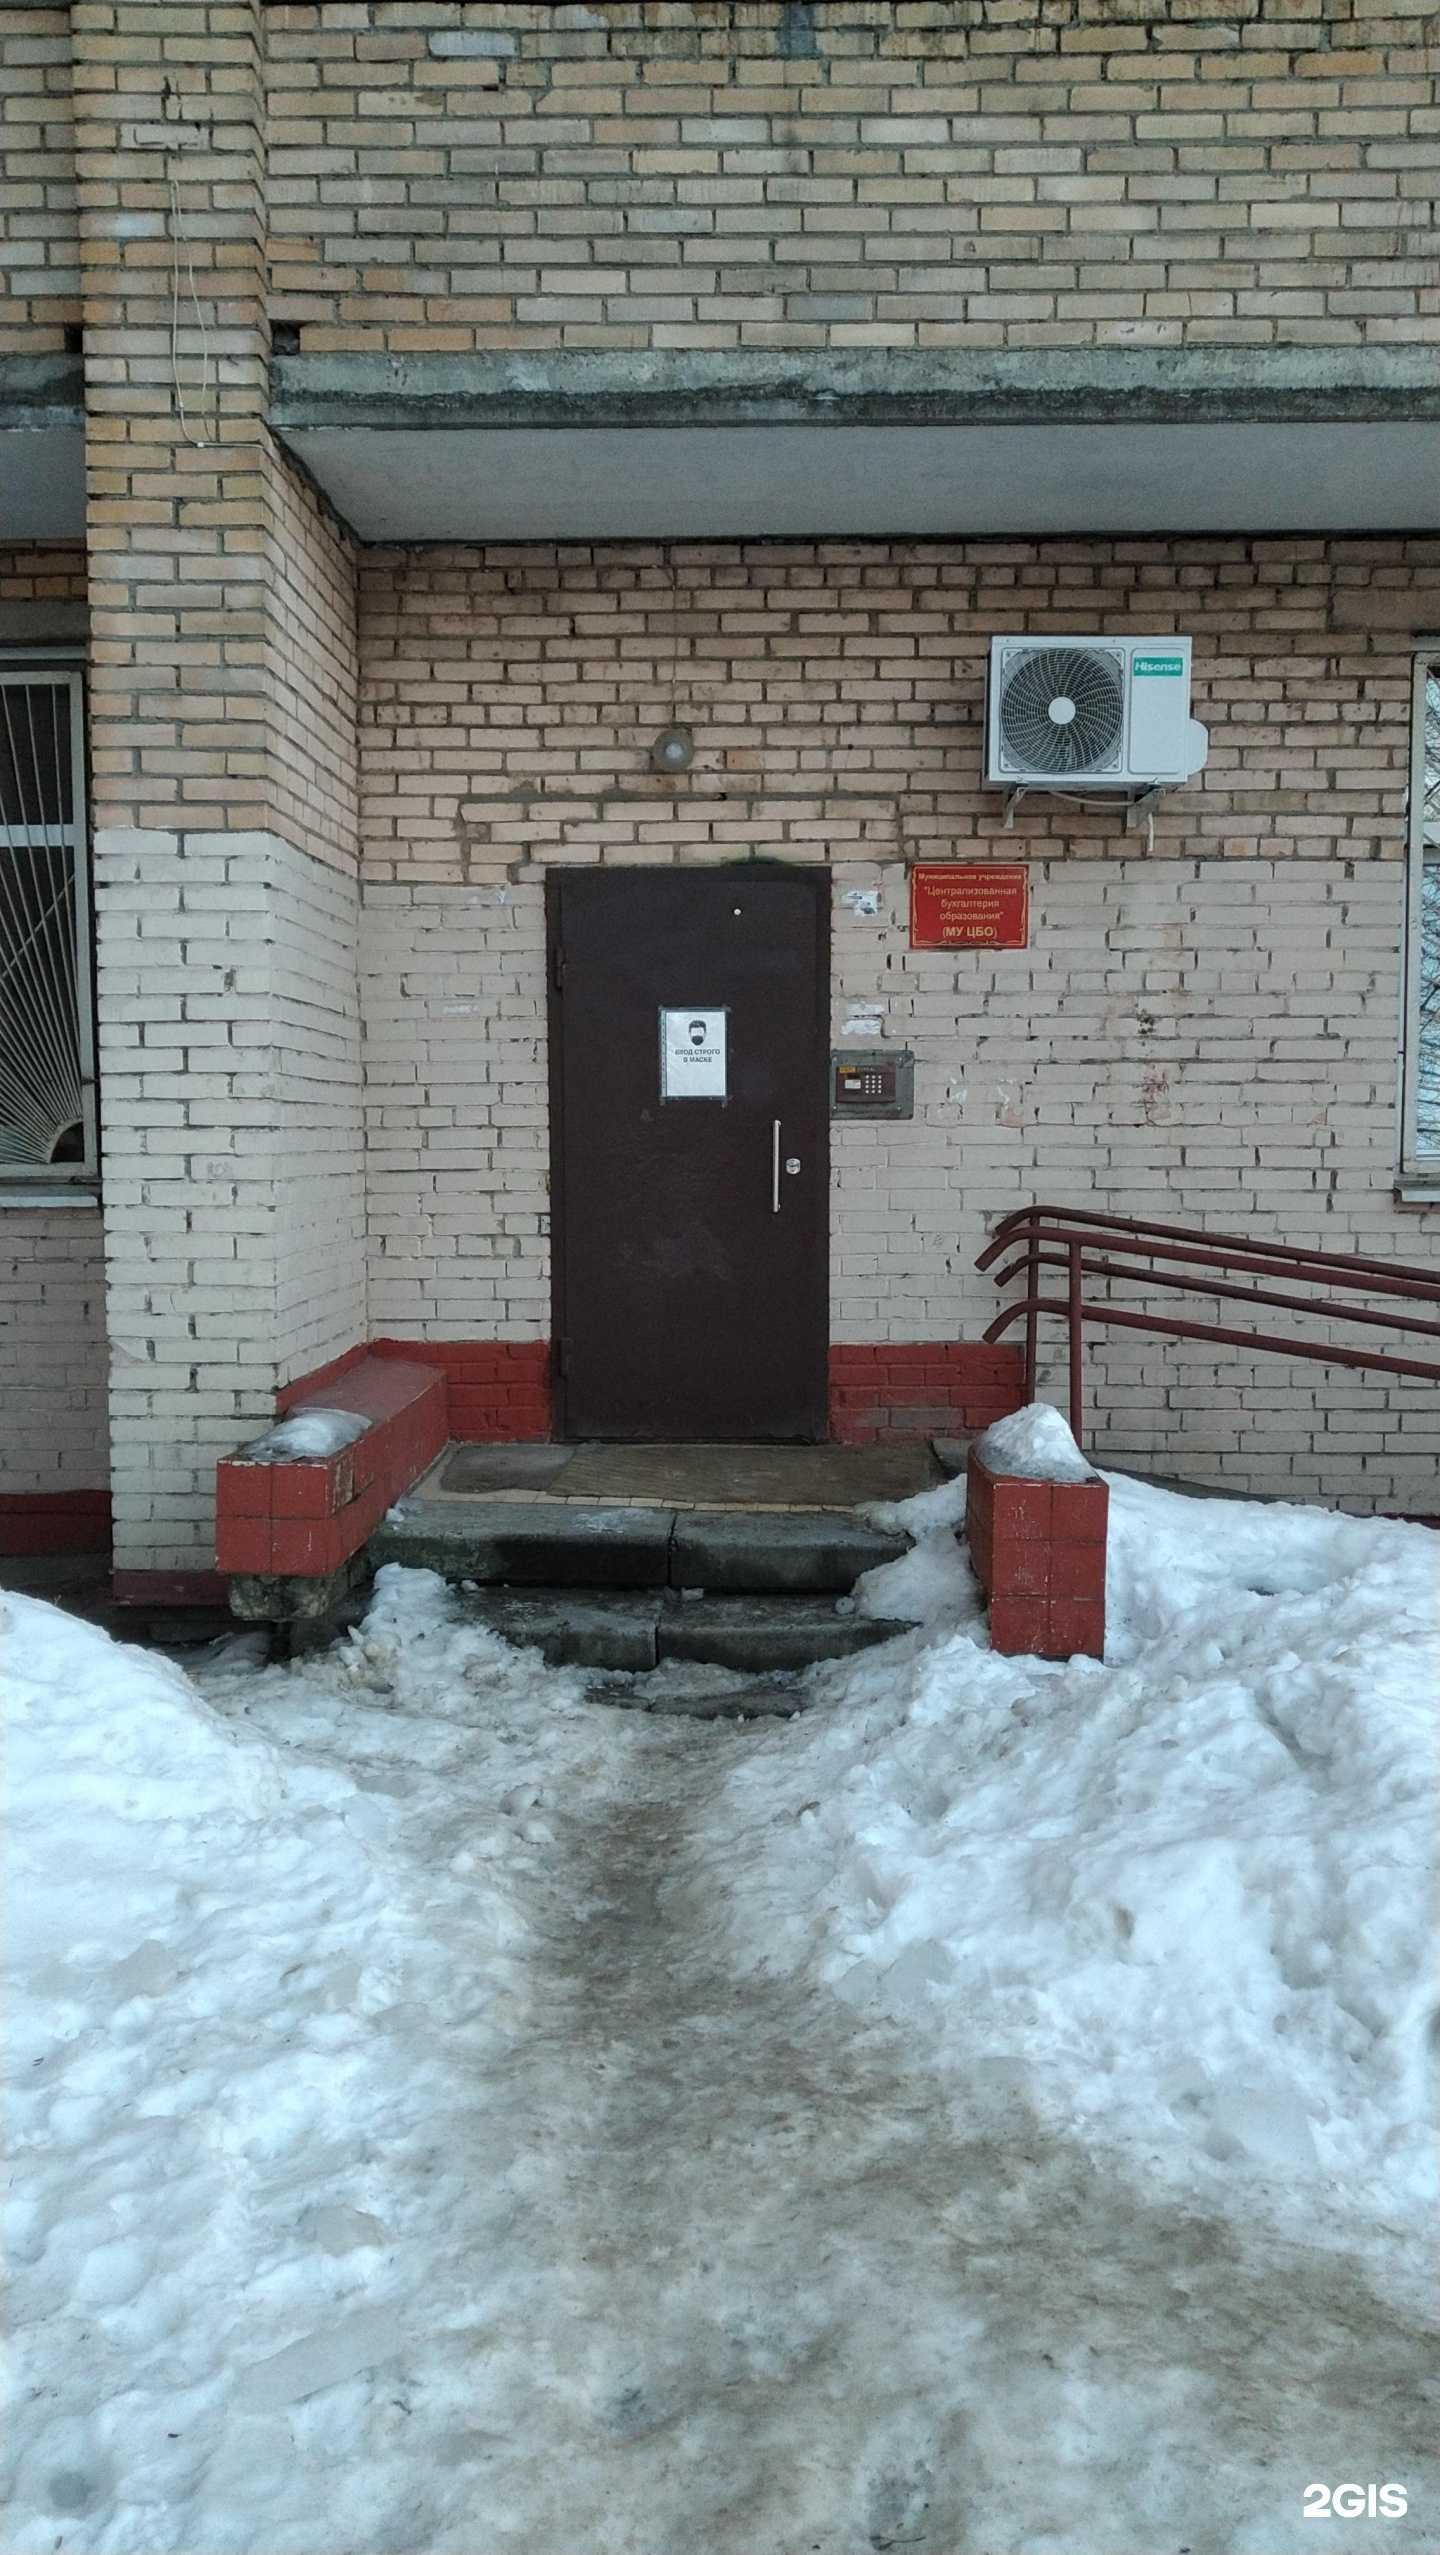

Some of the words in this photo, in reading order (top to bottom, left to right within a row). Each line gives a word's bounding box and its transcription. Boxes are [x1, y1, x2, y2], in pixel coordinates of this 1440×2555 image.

[1135, 661, 1181, 671] Hisense
[941, 899, 999, 909] бухгалтерия
[940, 911, 1004, 921] образования"
[942, 926, 964, 937] (МУ
[966, 926, 998, 938] ЦБО)
